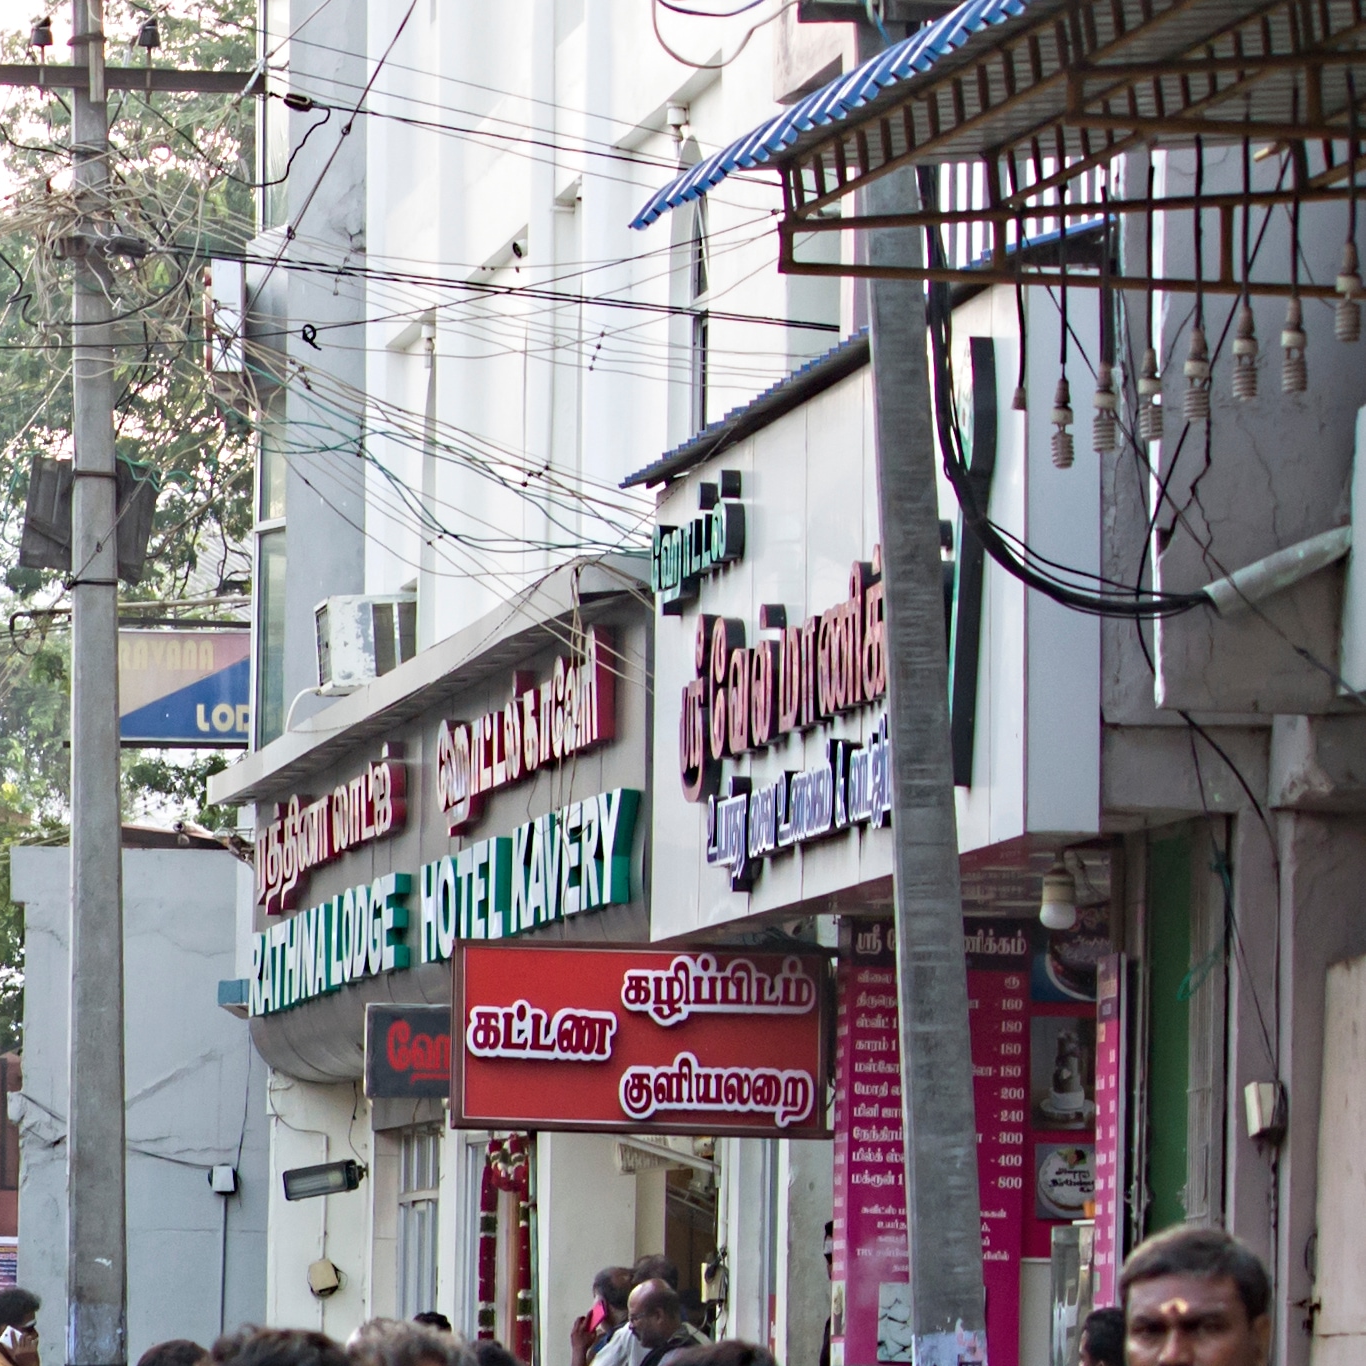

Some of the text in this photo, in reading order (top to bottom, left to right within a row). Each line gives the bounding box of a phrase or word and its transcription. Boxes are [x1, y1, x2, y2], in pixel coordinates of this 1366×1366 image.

[196, 703, 249, 732] LOD
[421, 788, 622, 965] HOTEL KAVERY
[248, 874, 400, 1018] RATHNA LODGE
[623, 954, 816, 1022] கழிப்பிடம்
[468, 1001, 615, 1058] கட்டண
[621, 1052, 813, 1124] குளியலறை
